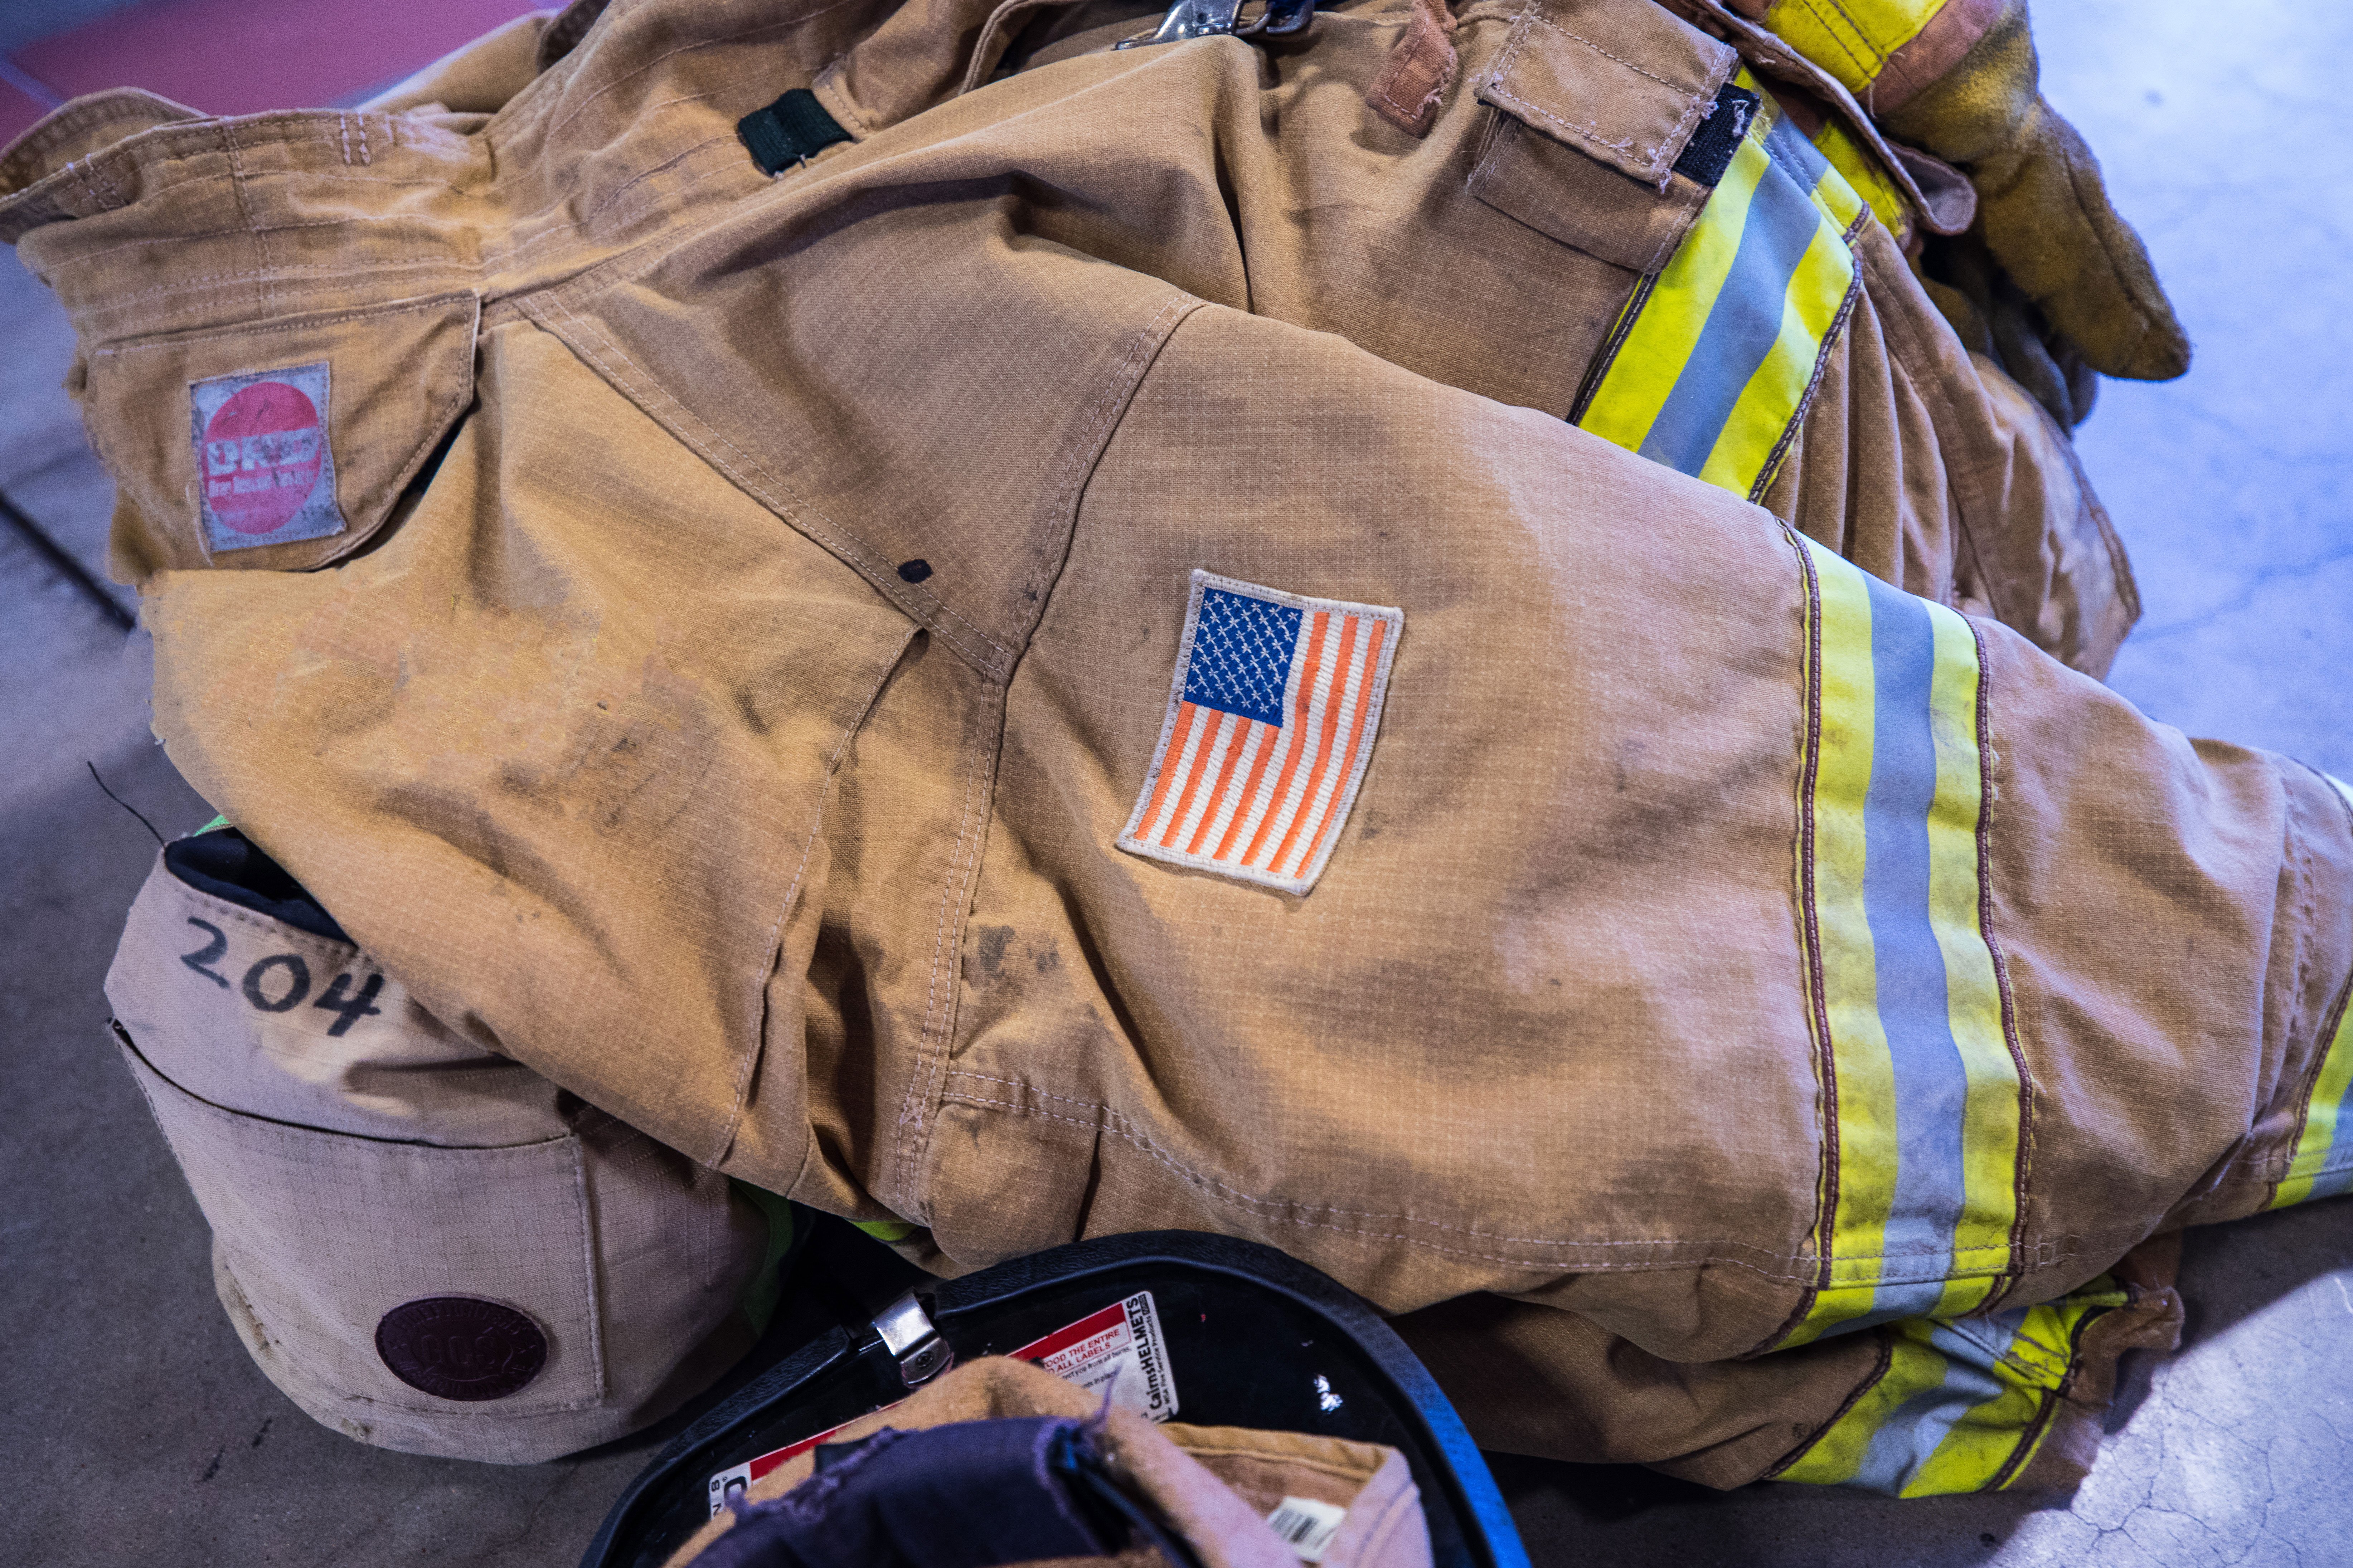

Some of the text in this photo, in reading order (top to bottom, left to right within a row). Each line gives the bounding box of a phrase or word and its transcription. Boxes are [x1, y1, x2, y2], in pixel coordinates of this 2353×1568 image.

[180, 916, 385, 1037] 204
[1069, 1344, 1087, 1357] THE
[1088, 1328, 1120, 1349] ENTIRE
[1146, 1315, 1158, 1347] Products
[1057, 1342, 1111, 1372] ALL LABELS
[1075, 1367, 1087, 1377] you
[1088, 1359, 1102, 1369] from
[1126, 1297, 1162, 1410] CairnsHELMETS
[1155, 1347, 1164, 1373] Service
